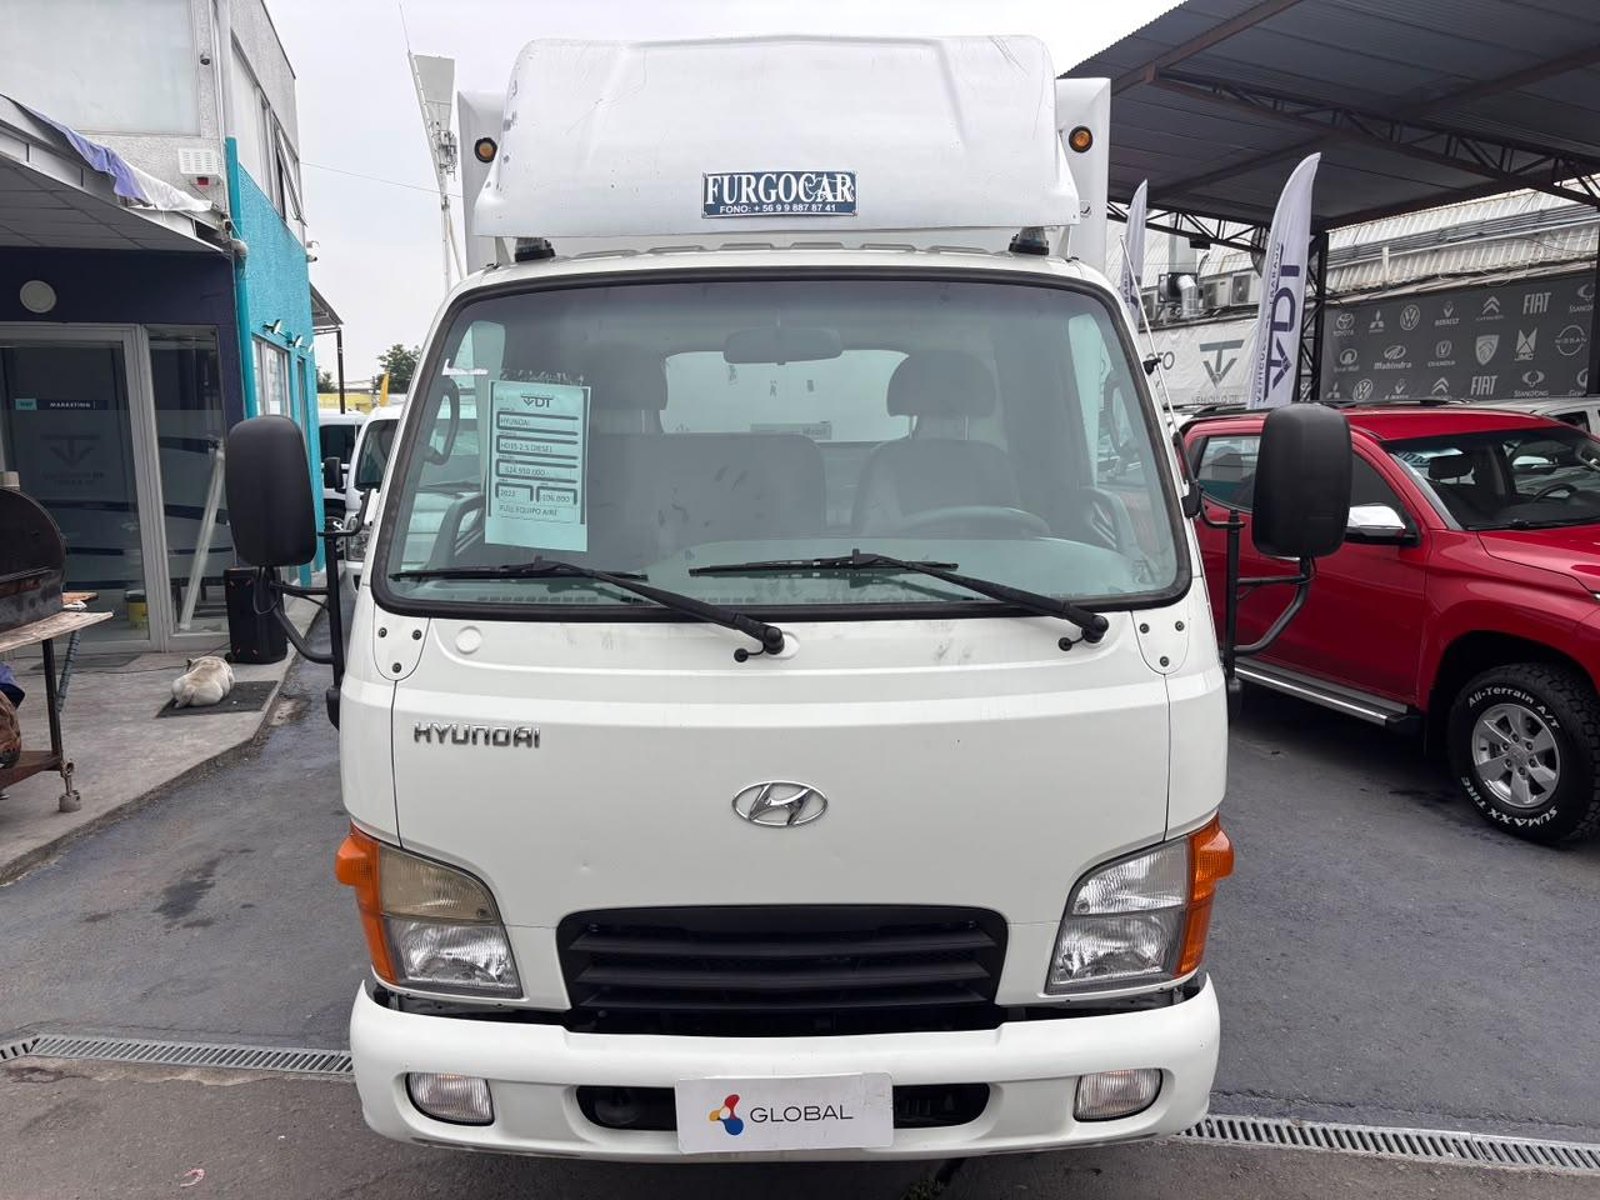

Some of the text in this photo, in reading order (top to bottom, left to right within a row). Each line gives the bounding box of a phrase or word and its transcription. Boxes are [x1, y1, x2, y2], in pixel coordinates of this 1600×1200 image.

[705, 173, 855, 205] FURGOCAR
[720, 205, 751, 213] FONO:
[1522, 292, 1552, 315] FIAT
[1374, 361, 1412, 370] Mahindra
[1470, 375, 1499, 395] FIAT
[1468, 686, 1560, 729] All-Terrain A/T
[413, 722, 541, 749] HYUNDAI
[749, 1105, 854, 1124] GLOBAL
